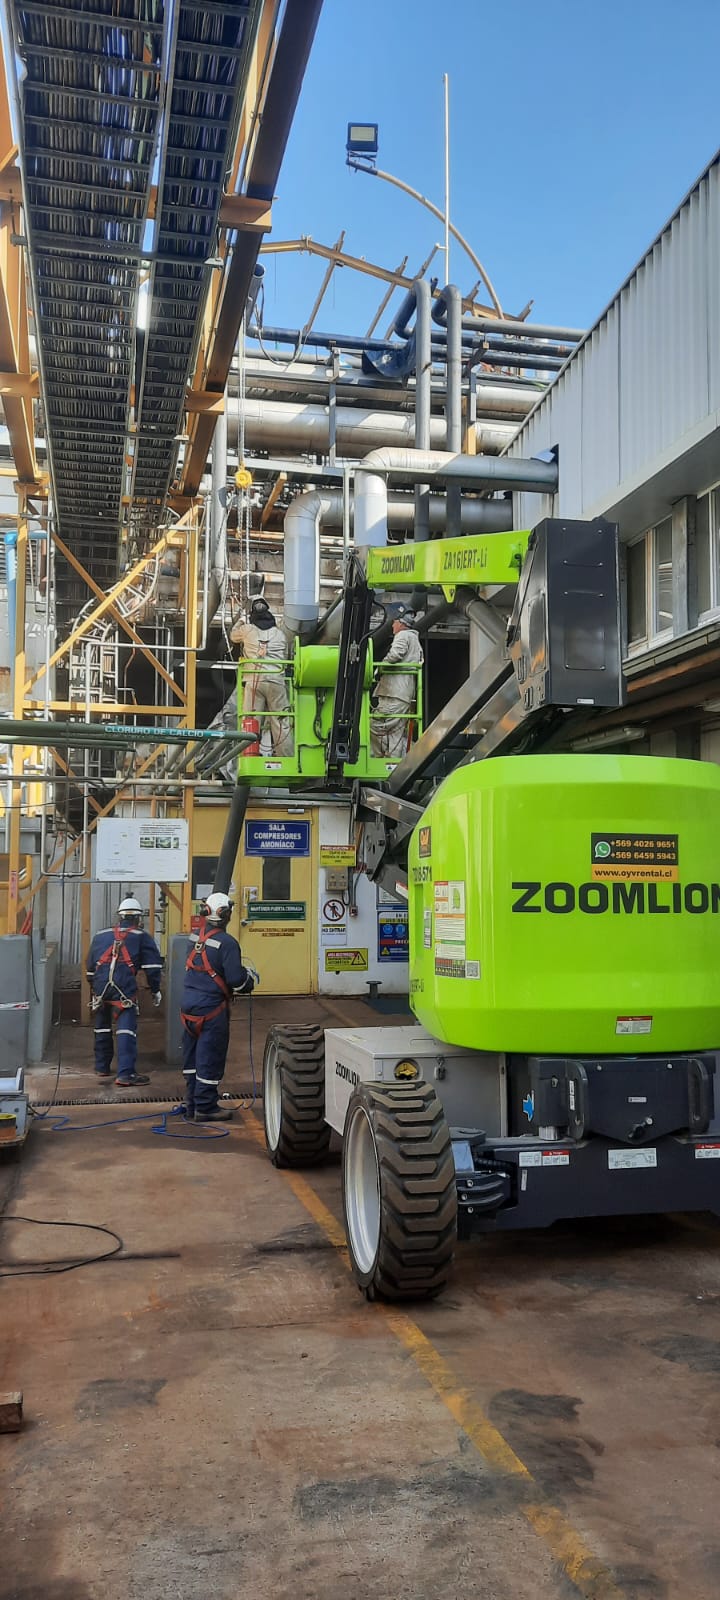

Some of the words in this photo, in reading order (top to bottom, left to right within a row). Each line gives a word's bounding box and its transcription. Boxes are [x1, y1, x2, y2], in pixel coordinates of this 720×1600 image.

[381, 554, 416, 574] ZOOMLION
[104, 725, 151, 735] CLORURO
[153, 727, 167, 736] DE
[169, 729, 204, 738] CALCIO
[253, 832, 302, 840] COMPRESORES
[610, 839, 632, 848] +569
[633, 840, 655, 848] 4026
[656, 841, 675, 849] 9651
[610, 851, 632, 859] +569
[633, 852, 655, 860] 6459
[656, 852, 676, 860] 5943
[594, 869, 672, 878] www.oyvrental.cl
